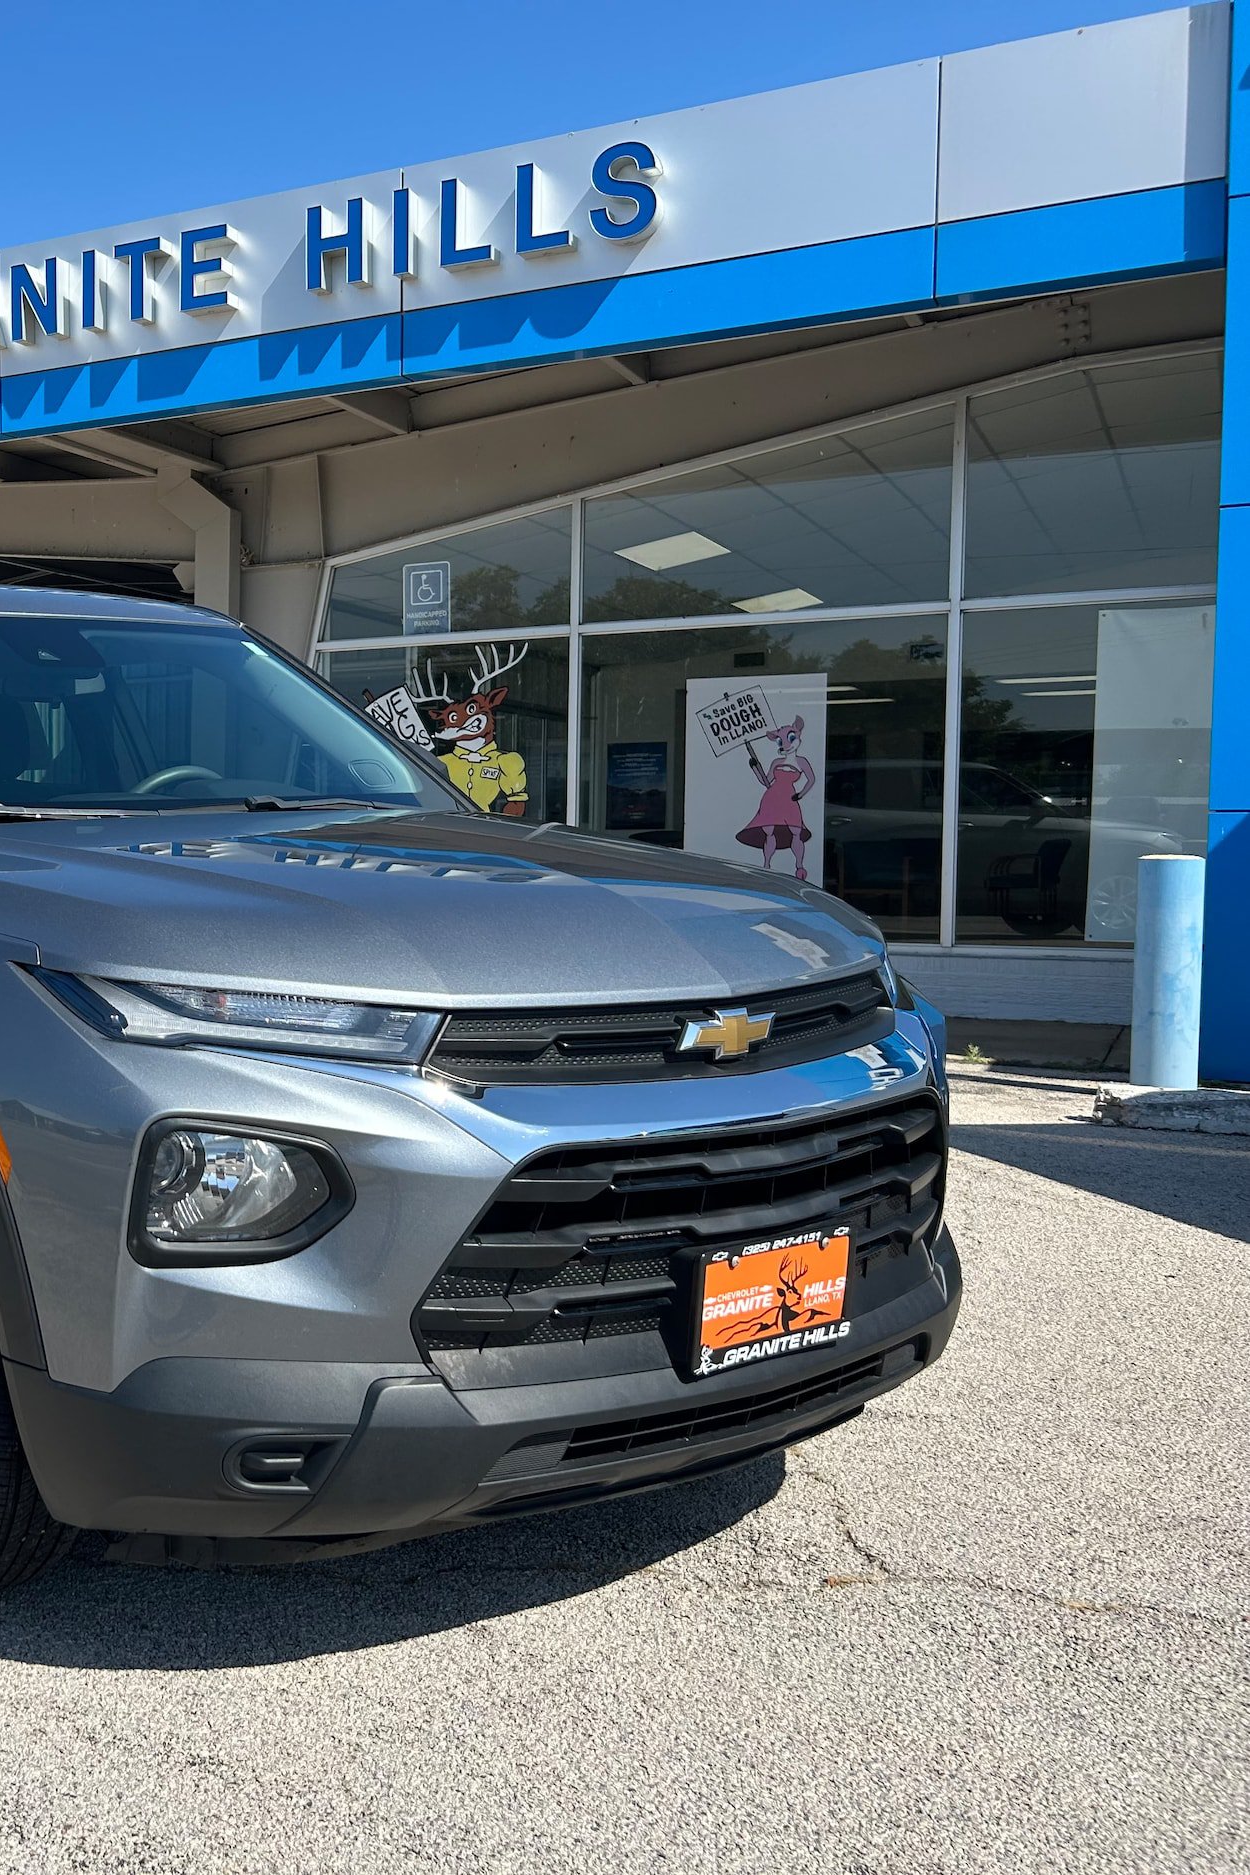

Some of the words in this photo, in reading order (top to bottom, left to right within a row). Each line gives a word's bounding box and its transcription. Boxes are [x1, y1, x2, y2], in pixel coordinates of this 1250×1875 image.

[305, 141, 661, 294] HILLS
[406, 609, 447, 619] HANDICAPPED
[413, 619, 440, 628] PARKING
[712, 703, 736, 718] Save
[736, 693, 754, 708] BIG
[709, 703, 763, 737] DOUGH
[729, 716, 768, 741] LLANO!
[741, 1242, 770, 1256] (325)
[772, 1231, 822, 1250] 247-4151
[716, 1286, 760, 1303] CHEVROLET
[803, 1276, 847, 1298] HILLS
[832, 1291, 842, 1300] TX
[702, 1292, 775, 1321] GRANITE
[722, 1332, 803, 1366] GRANITE
[802, 1320, 852, 1347] HILLS
